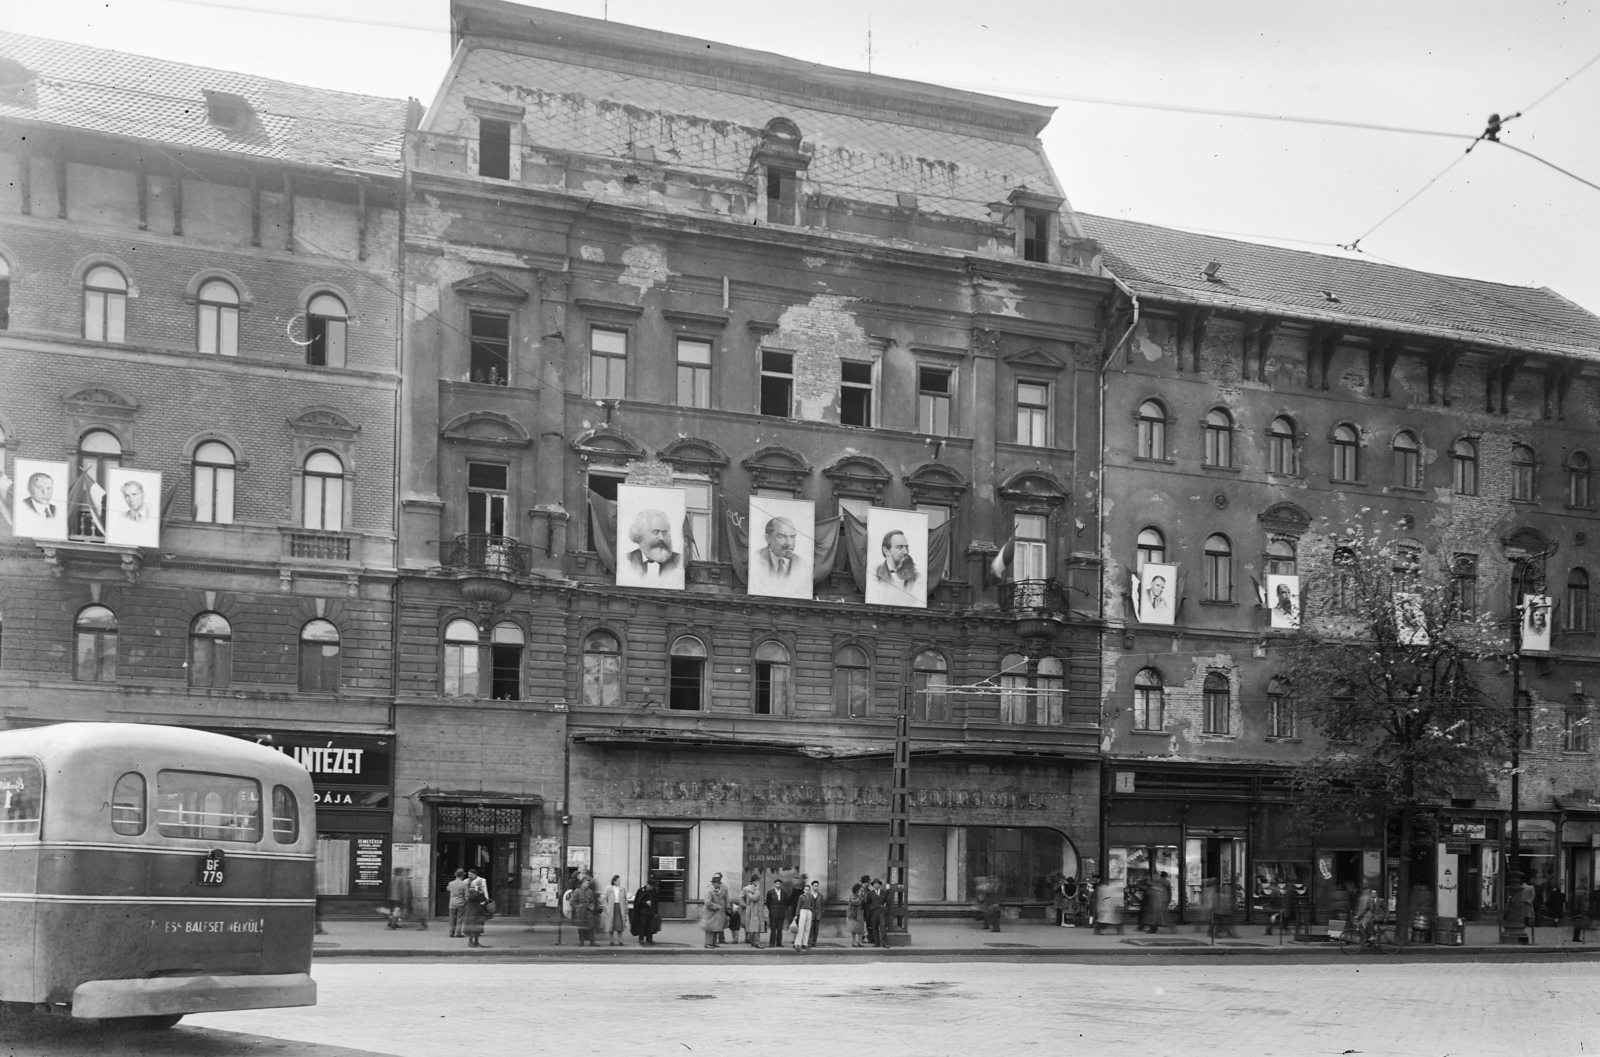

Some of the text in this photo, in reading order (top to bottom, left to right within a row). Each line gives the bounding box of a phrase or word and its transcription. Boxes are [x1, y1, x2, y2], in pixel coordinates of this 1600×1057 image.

[294, 741, 363, 774] INTÉZET
[314, 791, 353, 804] DÁJA
[206, 859, 220, 871] GF
[202, 870, 224, 883] 779
